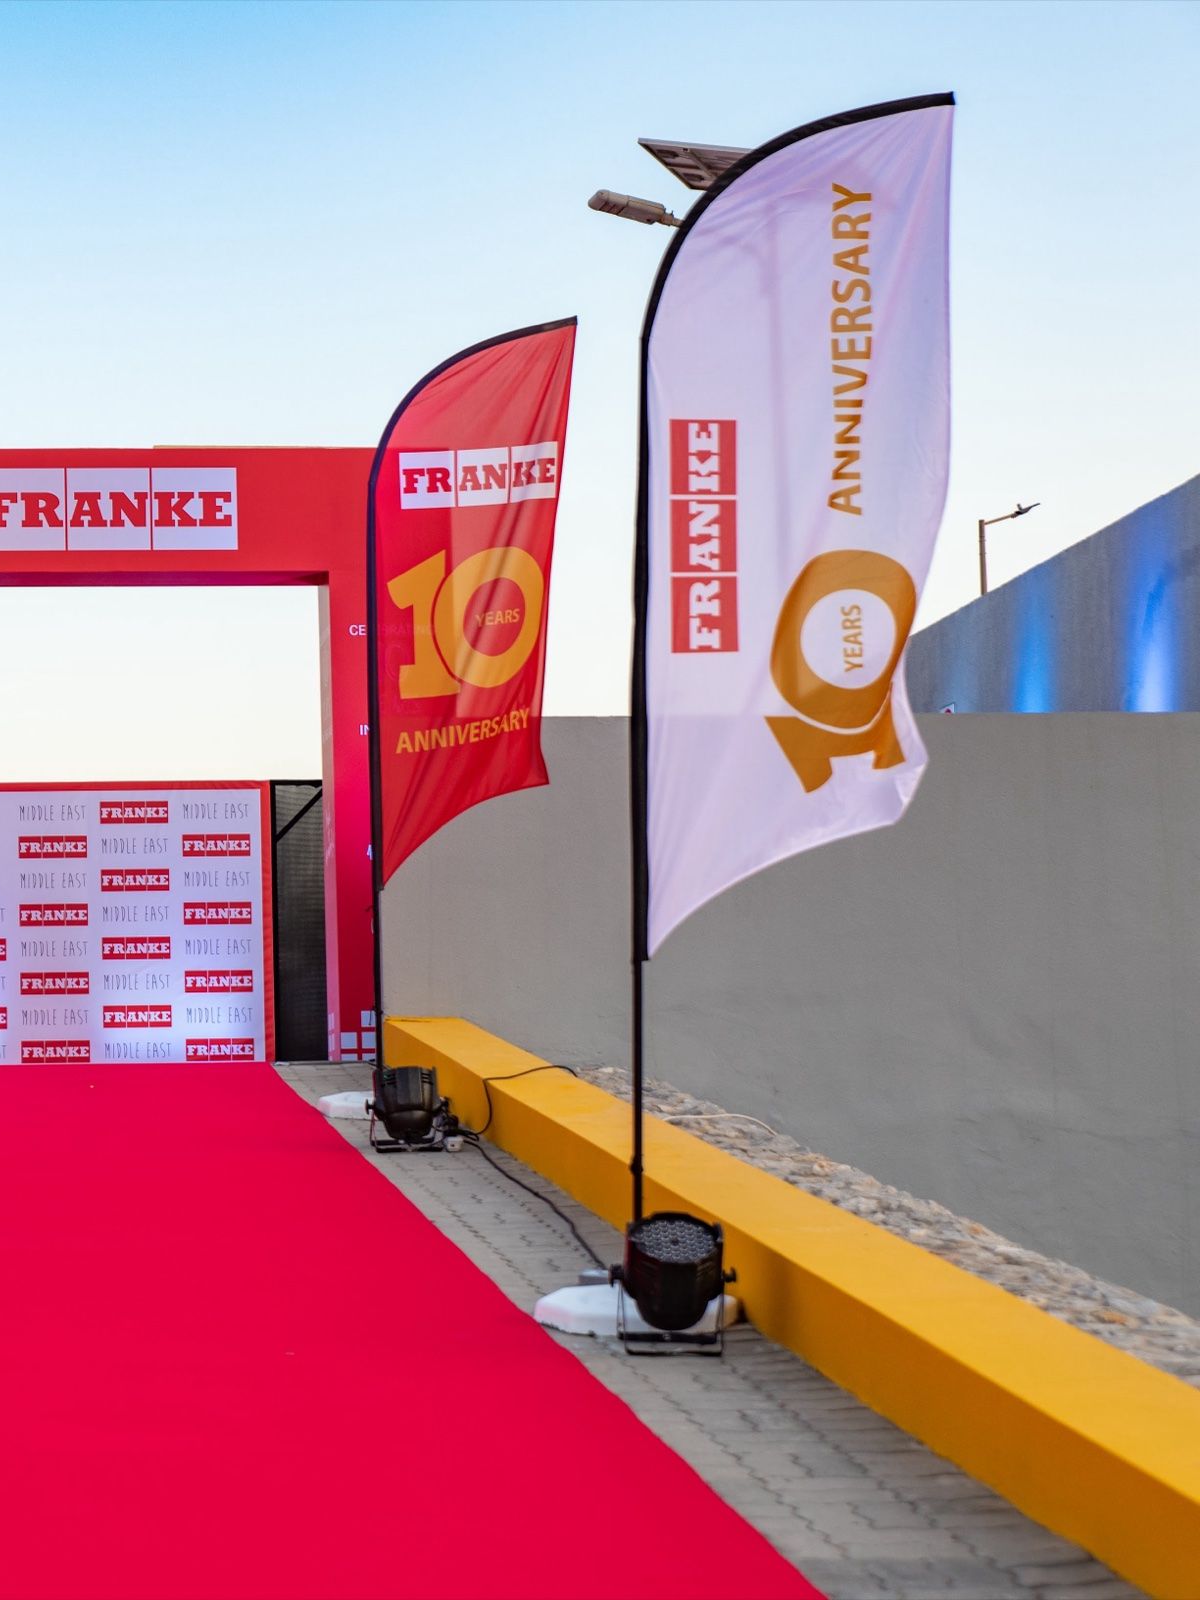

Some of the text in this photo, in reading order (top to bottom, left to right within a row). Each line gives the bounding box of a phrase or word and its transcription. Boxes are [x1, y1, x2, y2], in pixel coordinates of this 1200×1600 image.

[827, 182, 872, 516] ANNIVERSARY
[402, 457, 556, 494] FRANKE
[689, 421, 721, 650] FRANKE
[474, 608, 521, 628] YEARS
[840, 604, 864, 673] YEARS
[395, 708, 530, 755] ANNIVERSARY
[19, 805, 86, 822] MIDDLE EAST
[100, 807, 168, 820] FRANKE
[182, 803, 249, 820] MIDDLE EAST
[19, 842, 87, 854] FRANKE
[101, 838, 168, 855] MIDDLE EAST
[182, 840, 250, 852] FRANKE
[20, 872, 87, 890] MIDDLE EAST
[101, 875, 169, 887] FRANKE
[183, 871, 250, 888] MIDDLE EAST
[20, 910, 87, 922] FRANKE
[102, 905, 169, 923] MIDDLE EAST
[184, 908, 251, 920] FRANKE
[21, 940, 88, 958] MIDDLE EAST
[102, 943, 170, 955] FRANKE
[185, 938, 252, 956] MIDDLE EAST
[21, 978, 88, 990] FRANKE
[103, 973, 170, 991] MIDDLE EAST
[185, 976, 252, 988] FRANKE
[21, 1008, 88, 1026] MIDDLE EAST
[103, 1011, 171, 1023] FRANKE
[186, 1006, 253, 1024] MIDDLE EAST
[21, 1046, 89, 1058] FRANKE
[104, 1042, 171, 1059] MIDDLE EAST
[186, 1044, 254, 1056] FRANKE
